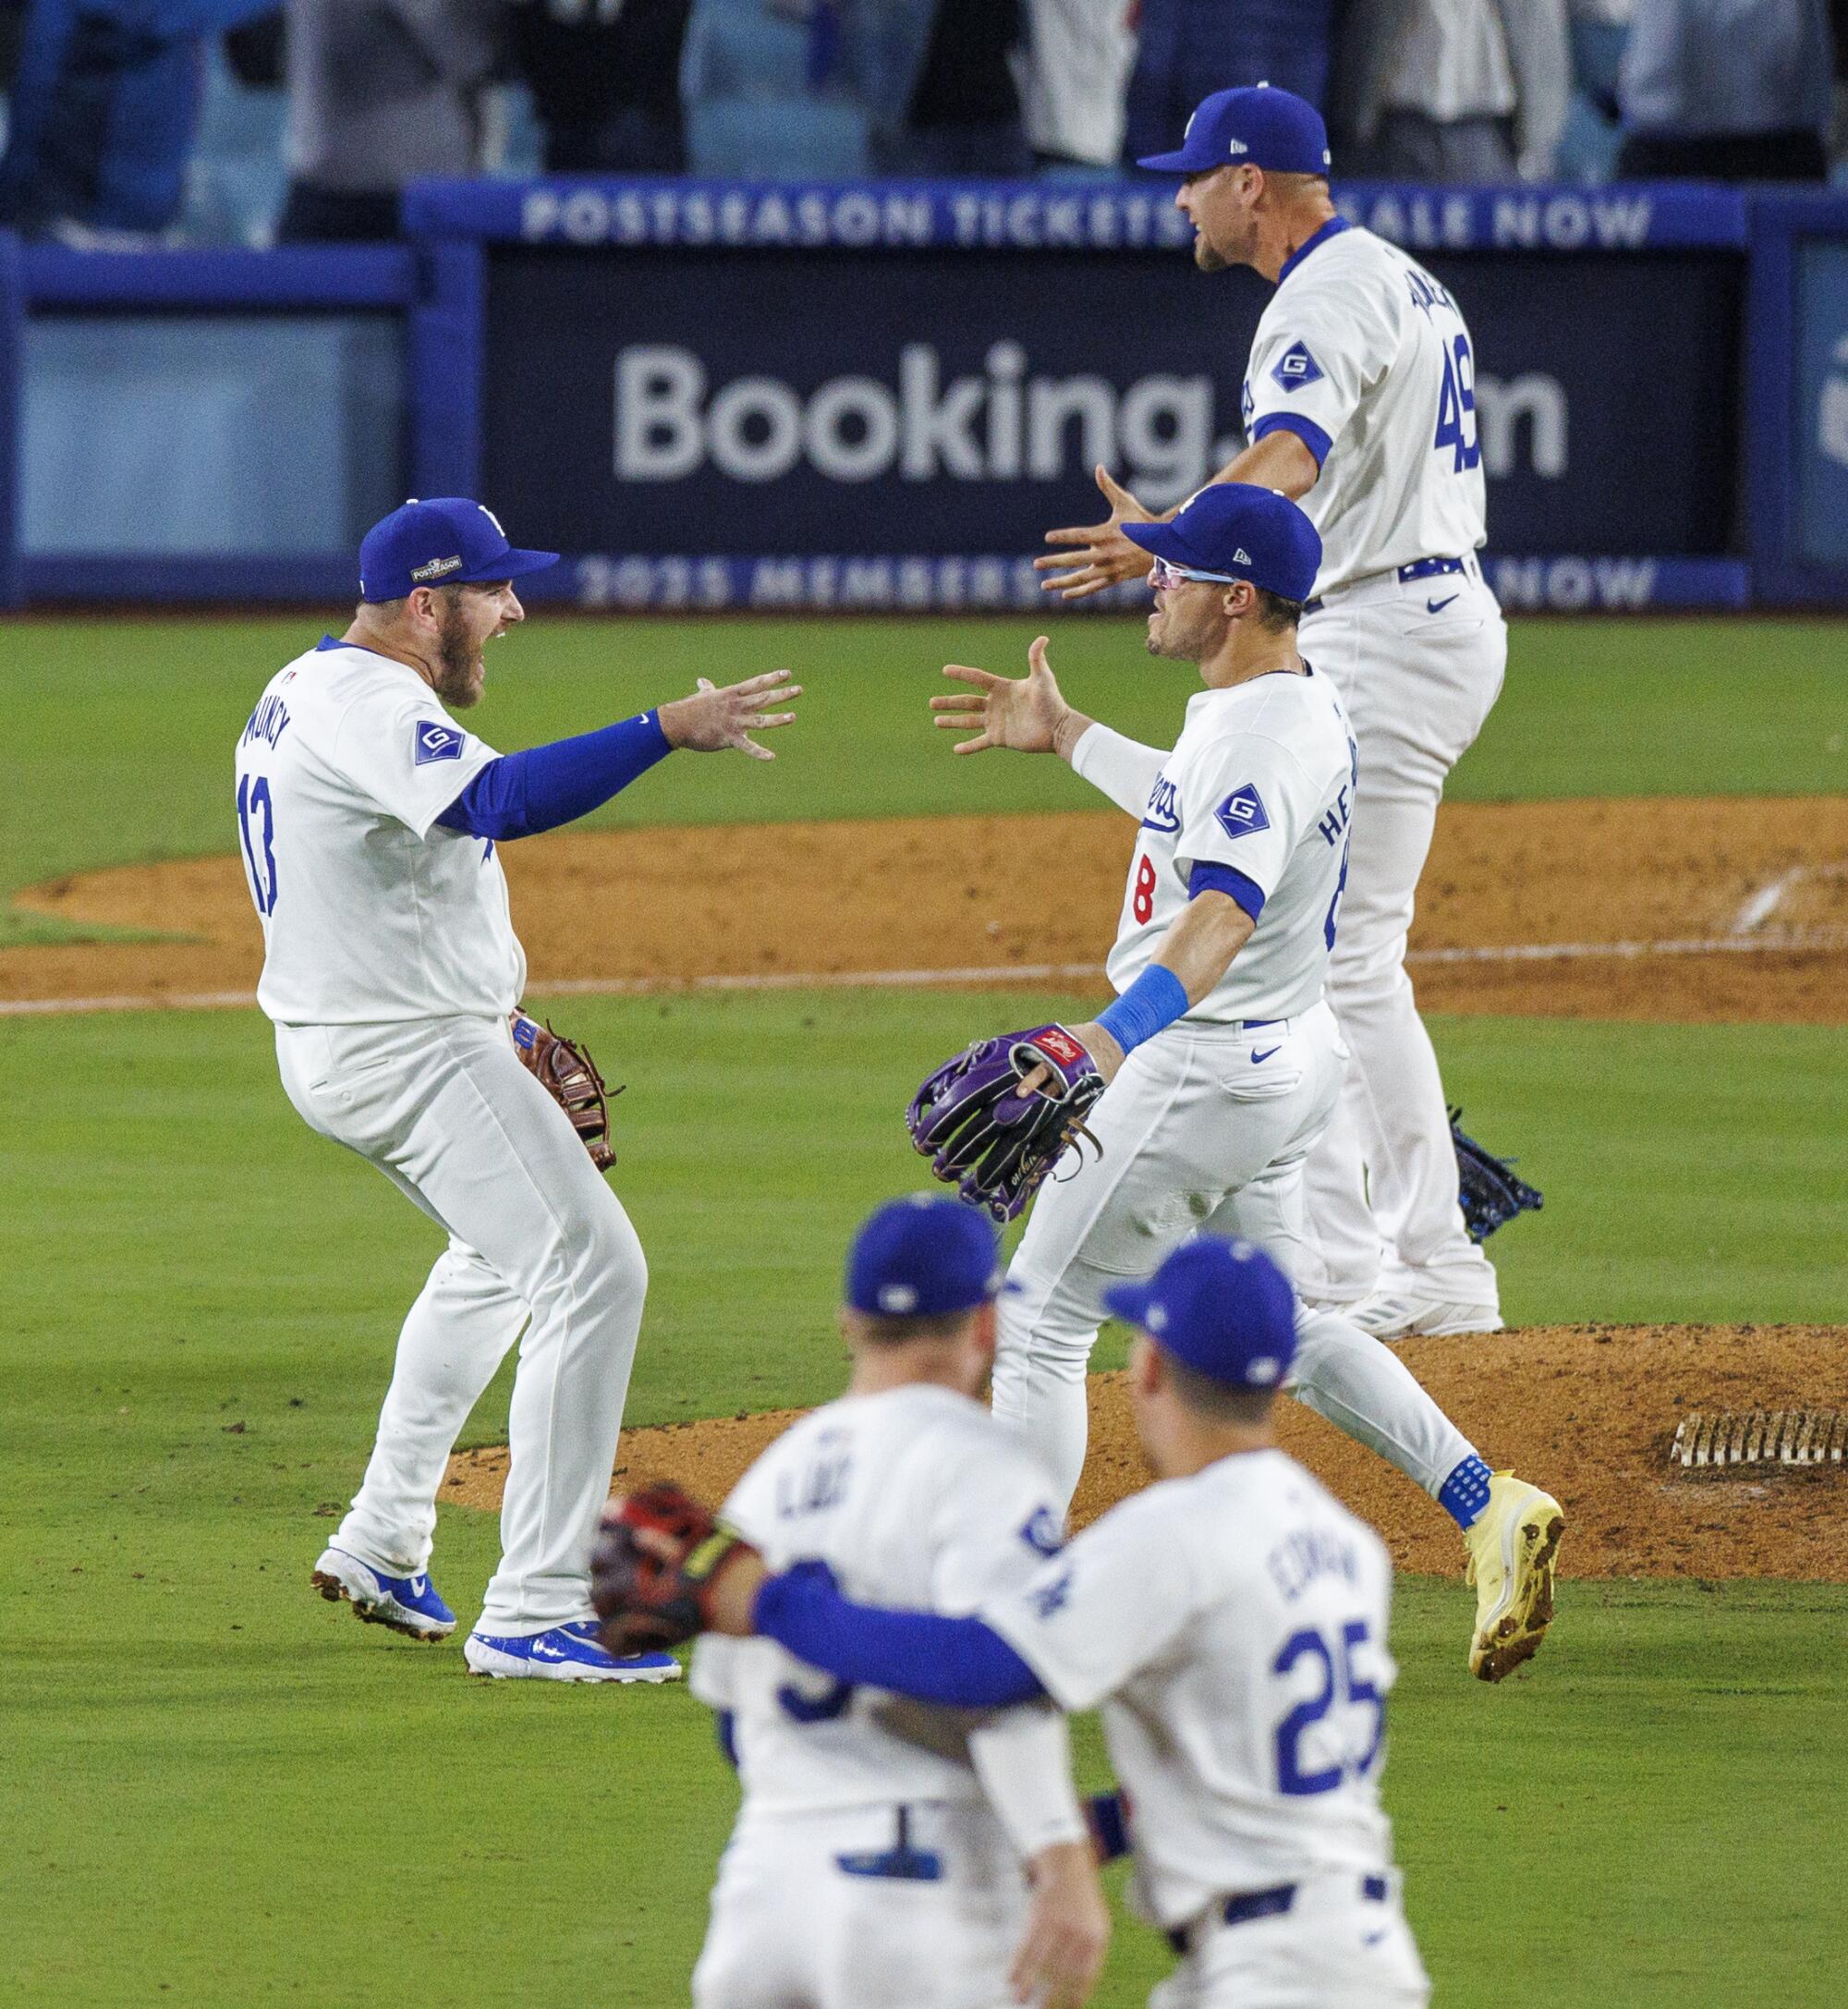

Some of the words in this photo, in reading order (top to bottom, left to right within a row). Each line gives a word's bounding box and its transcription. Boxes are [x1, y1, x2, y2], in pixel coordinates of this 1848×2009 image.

[522, 190, 930, 245] POSTSEASON
[953, 191, 1190, 247] TICKETS
[1492, 196, 1652, 250] NOW
[1283, 354, 1307, 374] G
[614, 339, 1571, 511] Booking.m
[1434, 335, 1479, 473] 49
[1495, 557, 1658, 607] NOW
[243, 695, 291, 750] MUNCY
[422, 727, 451, 749] G
[1229, 797, 1258, 820] G
[237, 773, 278, 917] 13
[1133, 853, 1156, 926] 8
[1274, 1621, 1384, 1795] 25
